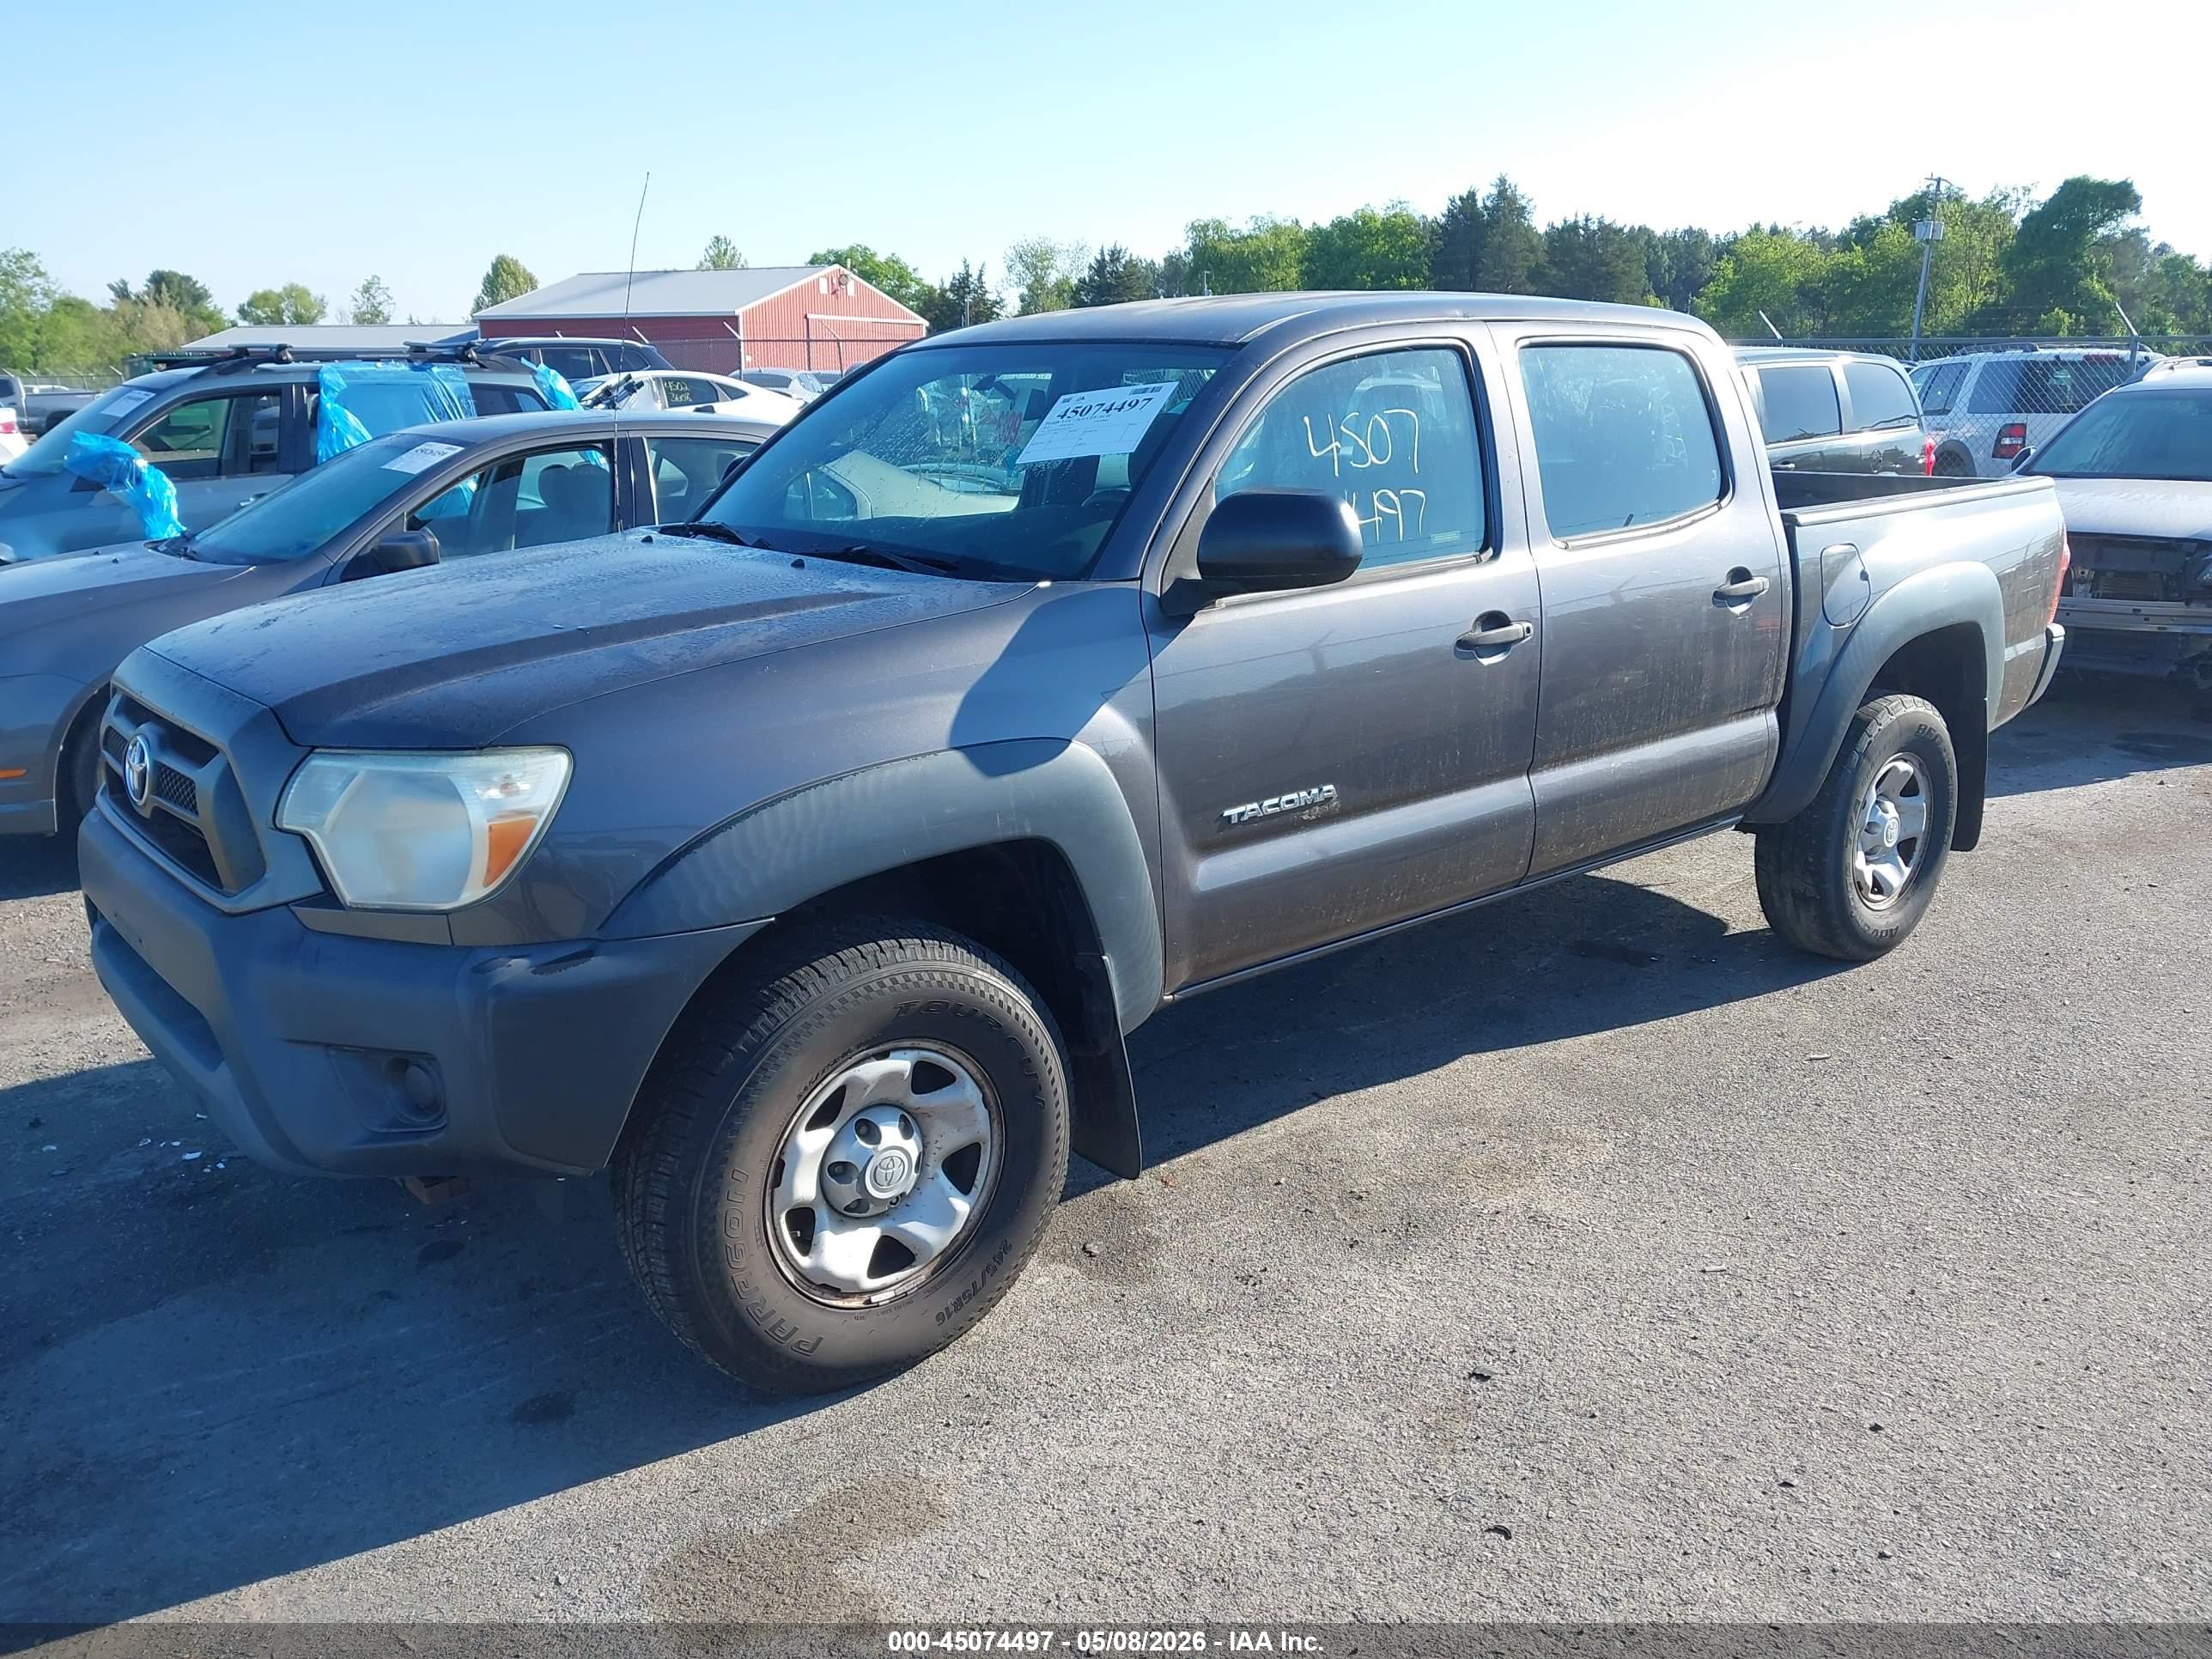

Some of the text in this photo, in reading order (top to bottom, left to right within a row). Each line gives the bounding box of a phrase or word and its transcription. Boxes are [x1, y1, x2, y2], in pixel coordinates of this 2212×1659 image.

[1057, 397, 1153, 420] 45074497
[1303, 409, 1419, 477] 4507
[1222, 784, 1338, 824] TACOMA
[723, 1167, 824, 1358] PARAGON
[934, 1237, 1013, 1328] 245/75R16
